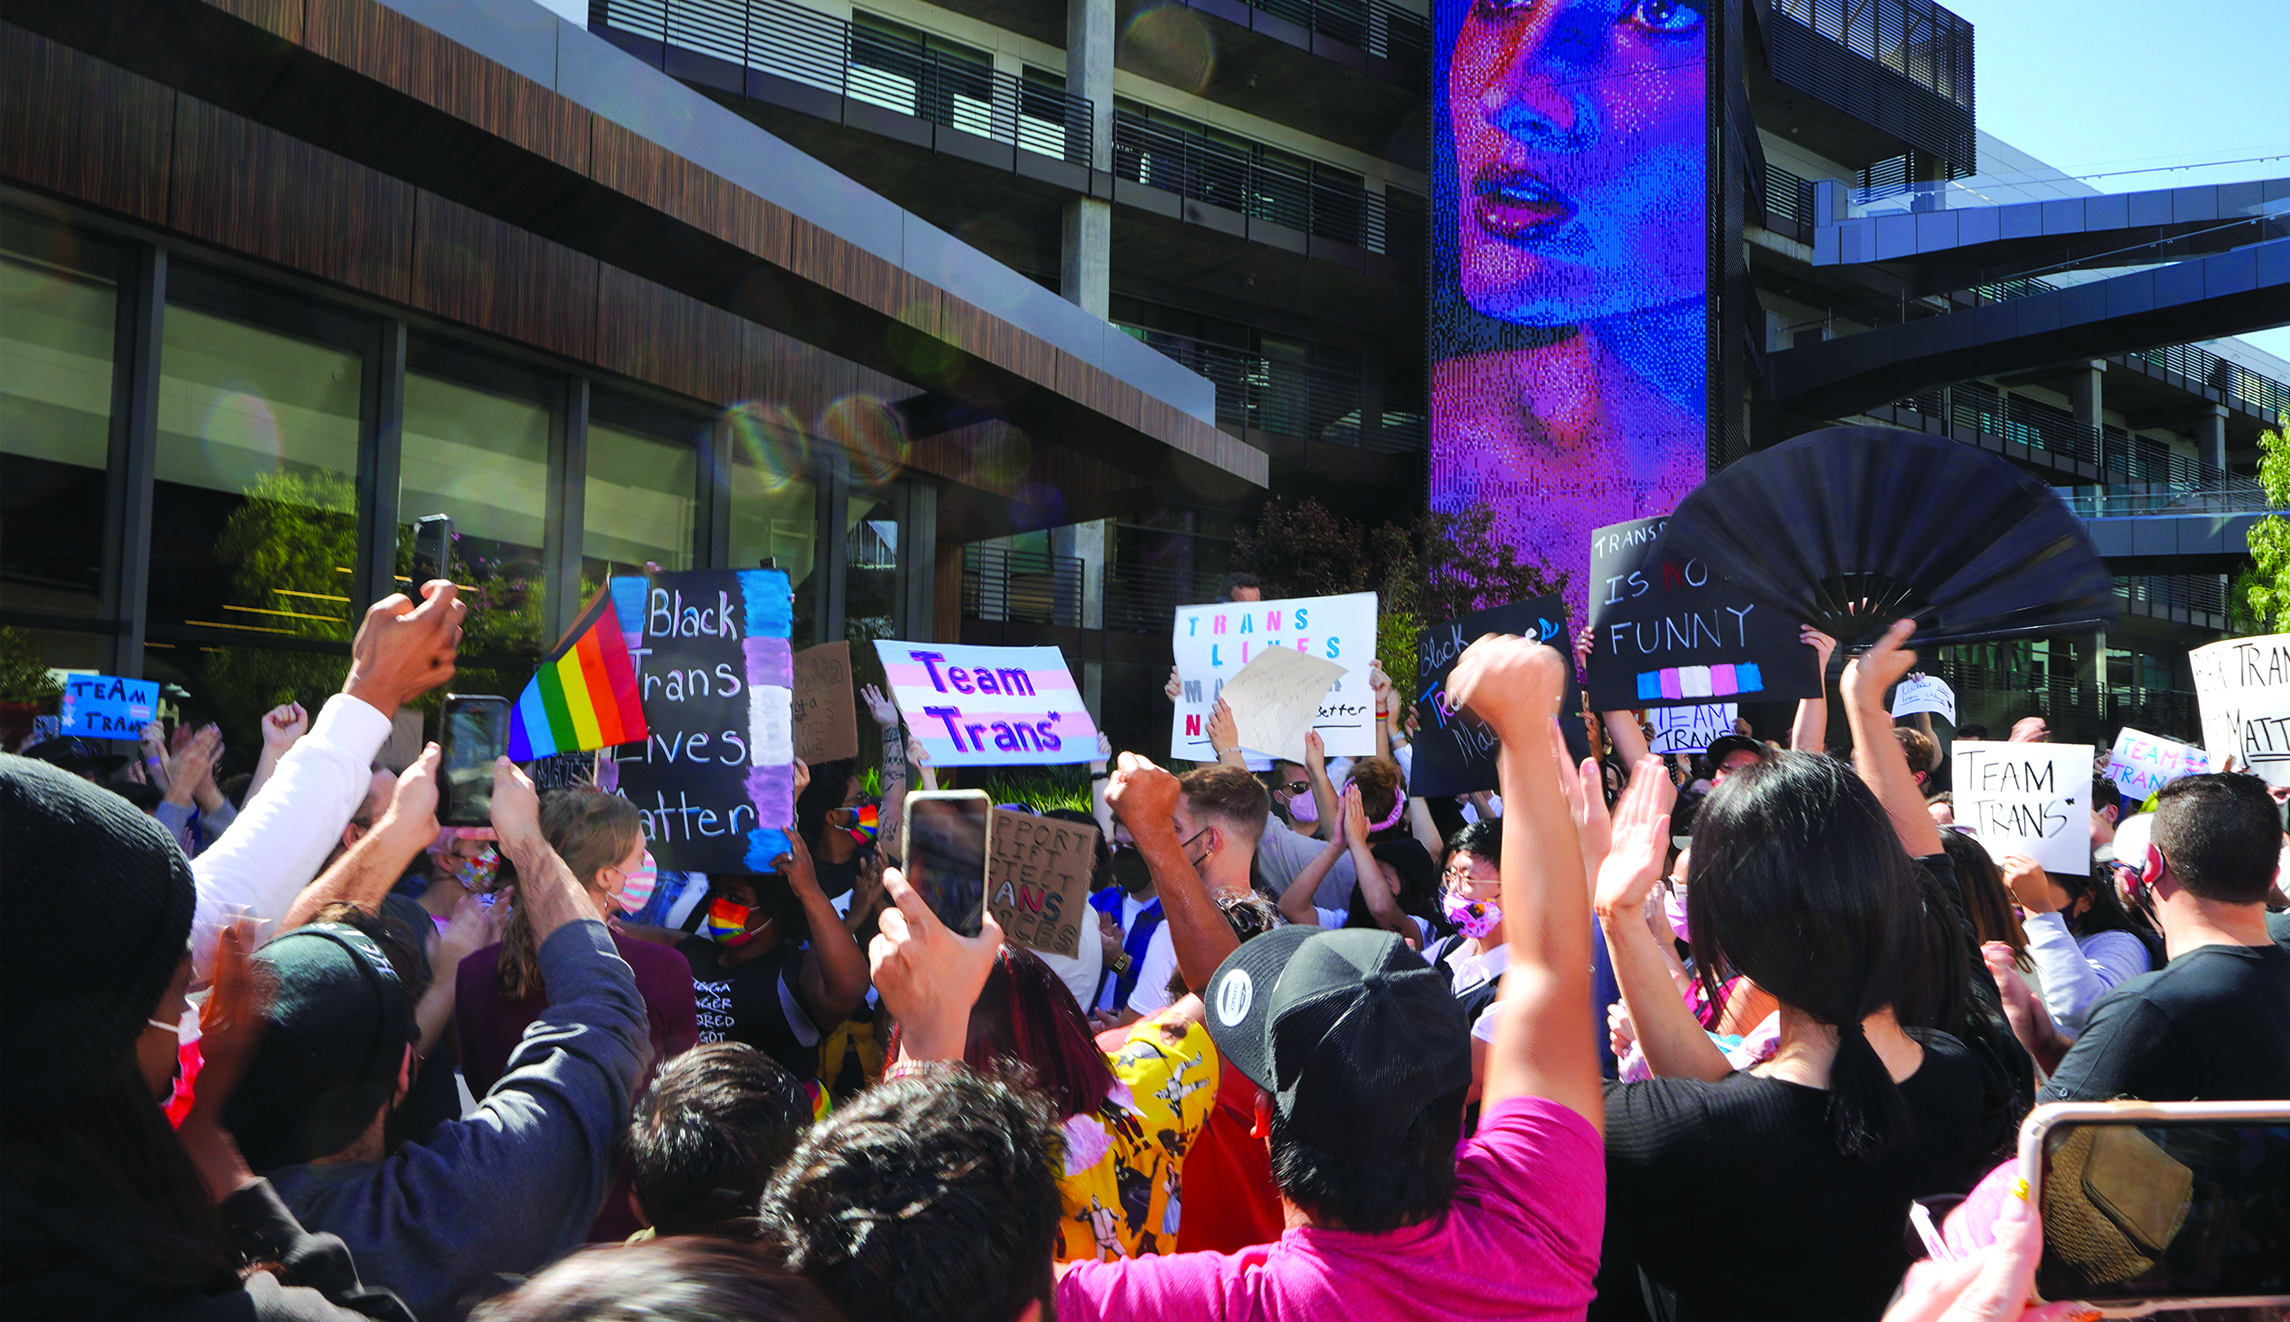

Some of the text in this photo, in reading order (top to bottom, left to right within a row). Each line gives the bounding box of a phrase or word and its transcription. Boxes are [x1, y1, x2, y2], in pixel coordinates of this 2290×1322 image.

[1604, 557, 1709, 606] IS NO
[649, 587, 738, 642] Black
[1188, 608, 1309, 637] TRANS
[1610, 603, 1755, 655] FUNNY
[1420, 624, 1470, 677] Black
[69, 677, 146, 705] TEAM
[907, 649, 1036, 696] Team
[1659, 703, 1730, 730] TEAM
[1957, 749, 2054, 793] TEAM
[2123, 737, 2181, 769] TEAM
[2110, 763, 2167, 790] TRAN
[990, 835, 1062, 869] LIFT
[996, 815, 1089, 856] PPORT
[988, 877, 1064, 922] ANS
[699, 1030, 726, 1044] GOT
